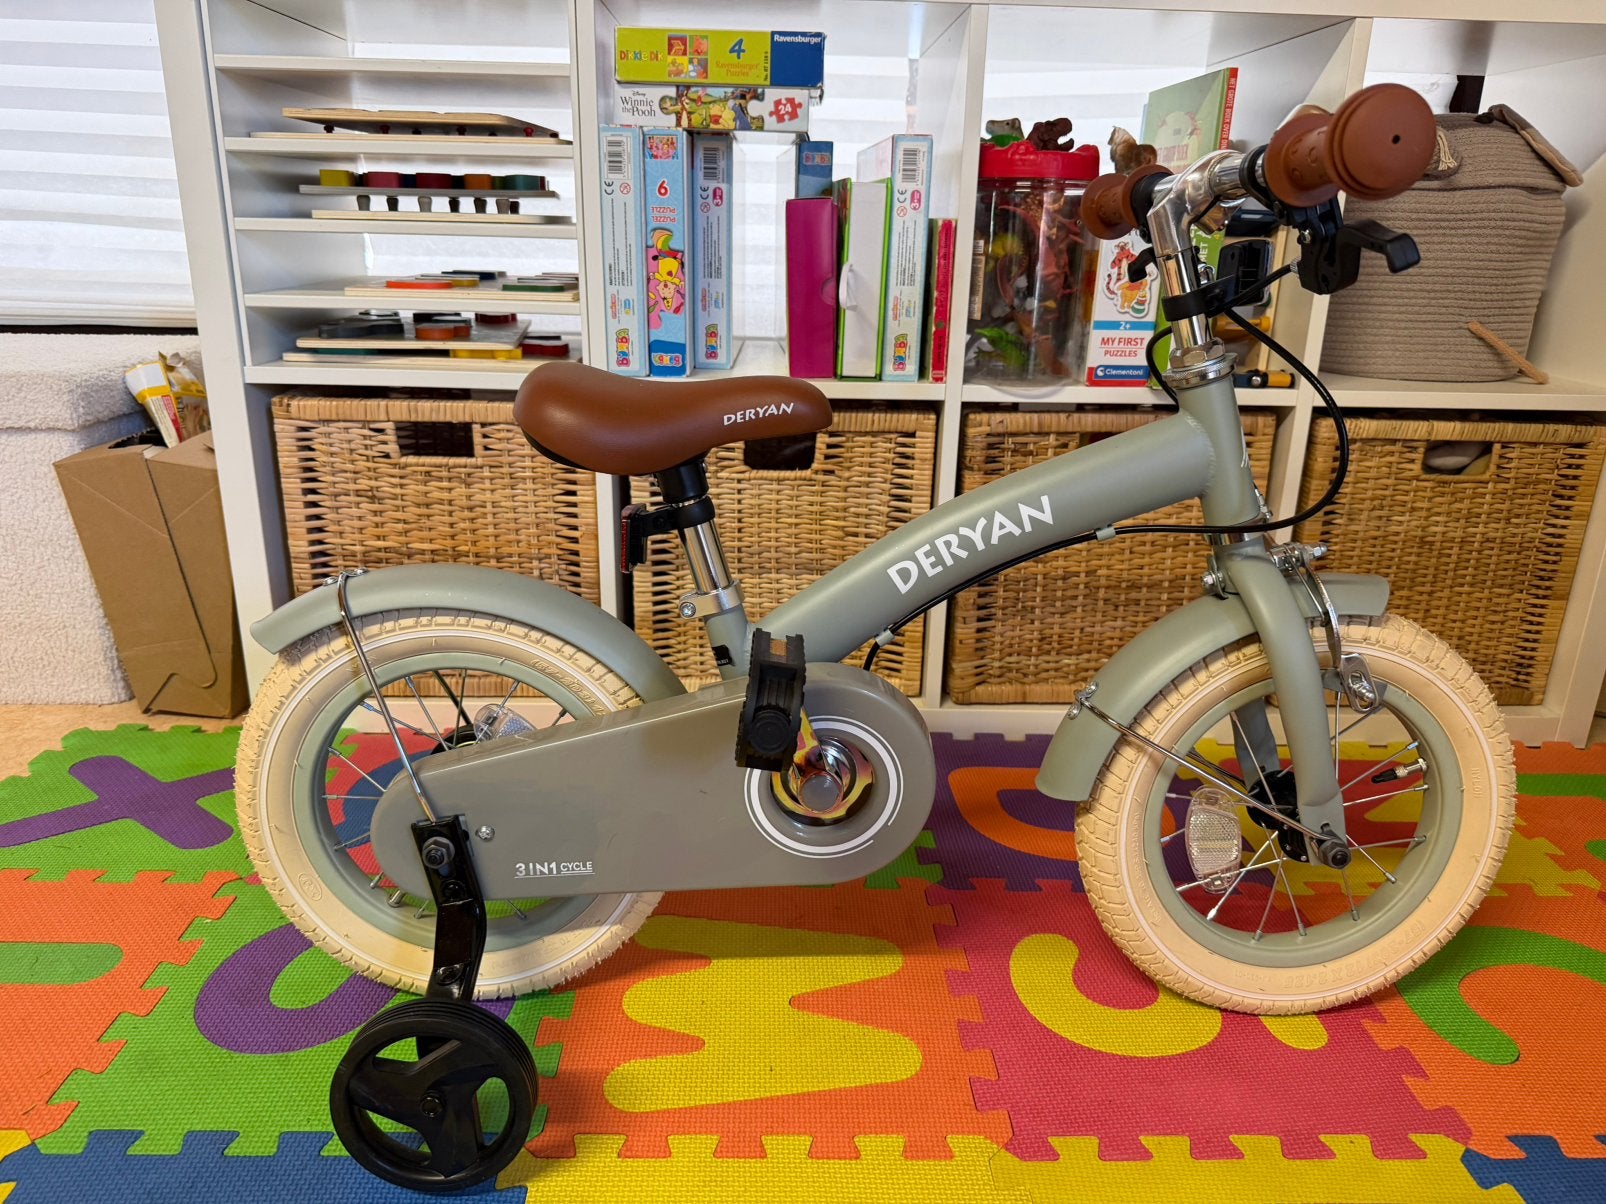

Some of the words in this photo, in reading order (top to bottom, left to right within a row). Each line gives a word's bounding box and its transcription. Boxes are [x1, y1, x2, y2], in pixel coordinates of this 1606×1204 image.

[774, 34, 822, 45] Ravensburger
[728, 38, 746, 60] 4
[650, 50, 663, 62] Dik
[620, 96, 654, 107] Winnie
[632, 106, 656, 117] Pooh
[779, 104, 792, 114] 24
[1119, 322, 1131, 330] 2+
[1100, 337, 1116, 346] MY
[1118, 337, 1145, 346] FIRST
[1105, 368, 1143, 376] Clementoni
[723, 402, 794, 426] DERYAN
[886, 495, 1054, 595] DERYAN
[560, 861, 593, 871] CYCLE
